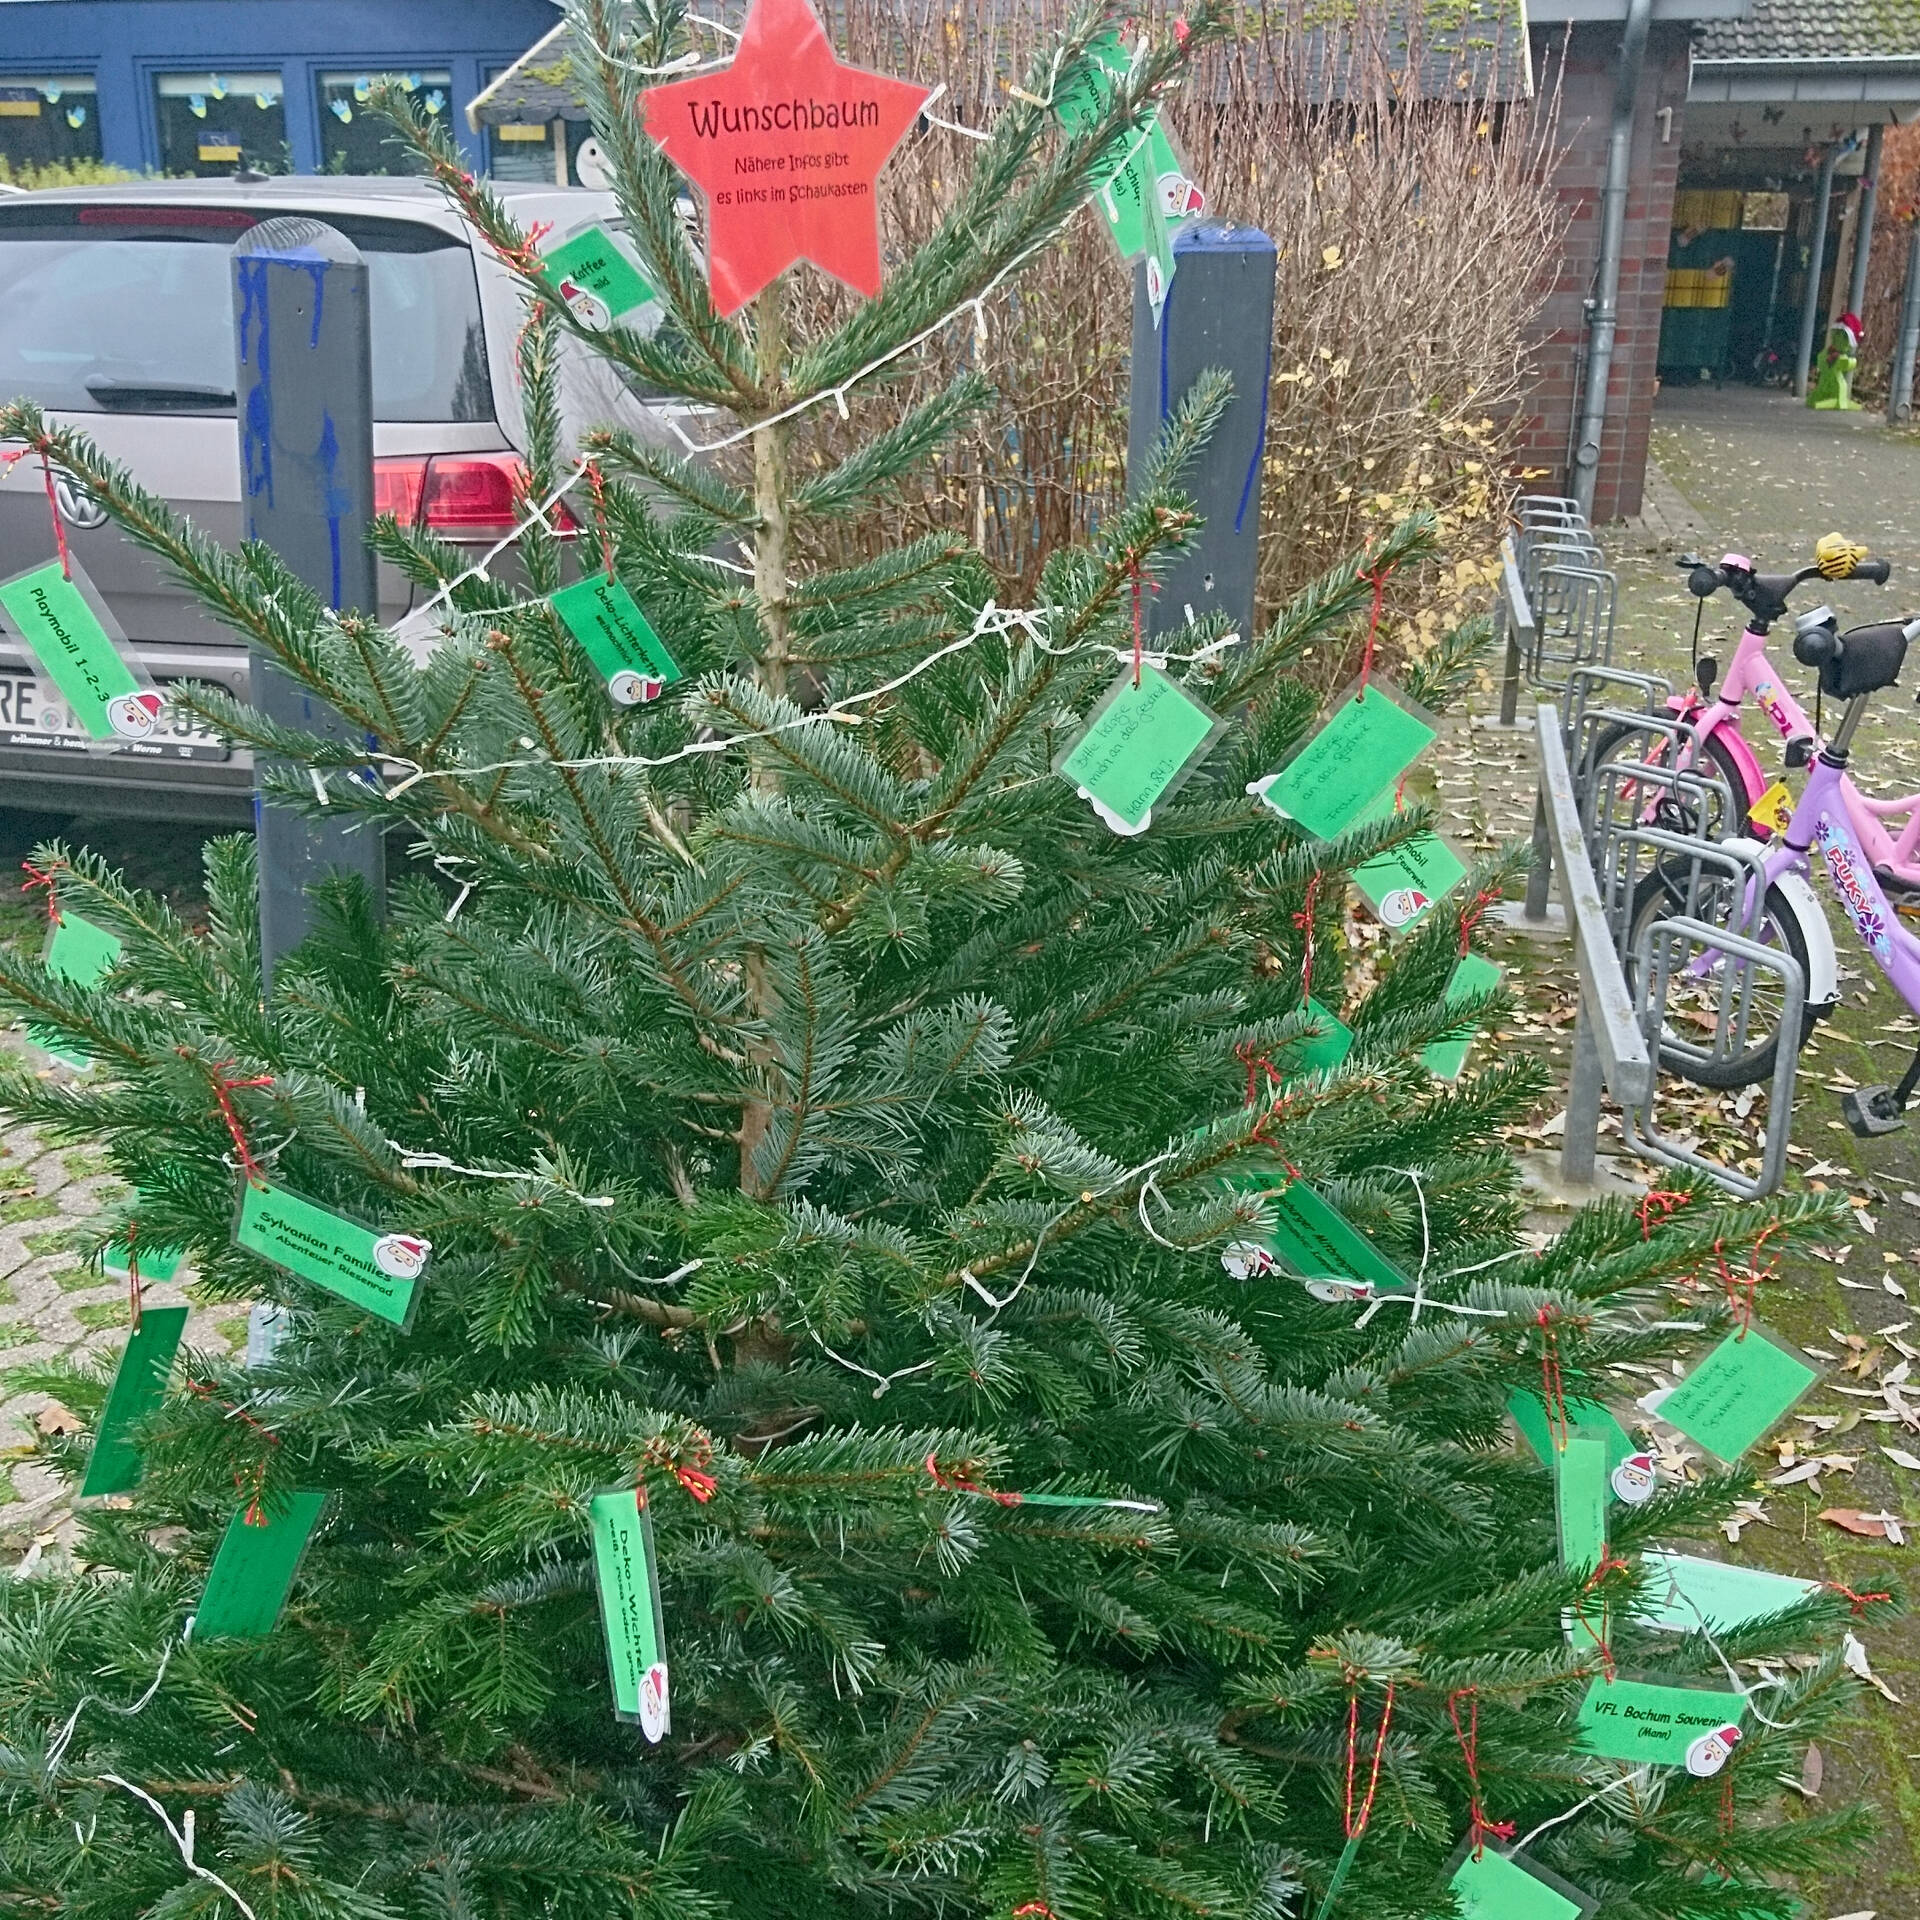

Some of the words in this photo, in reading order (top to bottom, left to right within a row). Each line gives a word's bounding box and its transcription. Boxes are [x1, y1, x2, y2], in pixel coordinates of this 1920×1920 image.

[687, 98, 878, 139] Wunschbaum
[1656, 106, 1672, 143] 1
[734, 155, 785, 174] Nähere
[789, 153, 821, 171] Infos
[824, 151, 849, 169] gibt
[717, 191, 732, 205] es
[736, 187, 767, 205] links
[771, 186, 785, 202] im
[789, 180, 868, 204] Schaukasten
[570, 258, 606, 282] Kaffee
[30, 587, 79, 654] Playmobil
[75, 659, 110, 702] 1-2-3
[594, 586, 660, 679] Deko-Lichterkette
[1121, 721, 1139, 742] das
[1396, 854, 1428, 889] Feuerwehr
[1402, 841, 1428, 868] mobil
[1827, 847, 1873, 916] PUKY
[259, 1211, 328, 1251] Sylvanian
[333, 1246, 393, 1282] Families
[276, 1235, 334, 1266] Abenteuer
[338, 1265, 394, 1297] Riesenrad
[615, 1566, 624, 1600] rosa
[619, 1529, 645, 1674] Deko-Wichtel
[621, 1608, 630, 1643] oder
[625, 1648, 636, 1686] grau
[1594, 1701, 1618, 1716] VFL
[1623, 1705, 1670, 1724] Bochum
[1674, 1712, 1727, 1728] Souvenir
[1637, 1727, 1672, 1741] (Mann)
